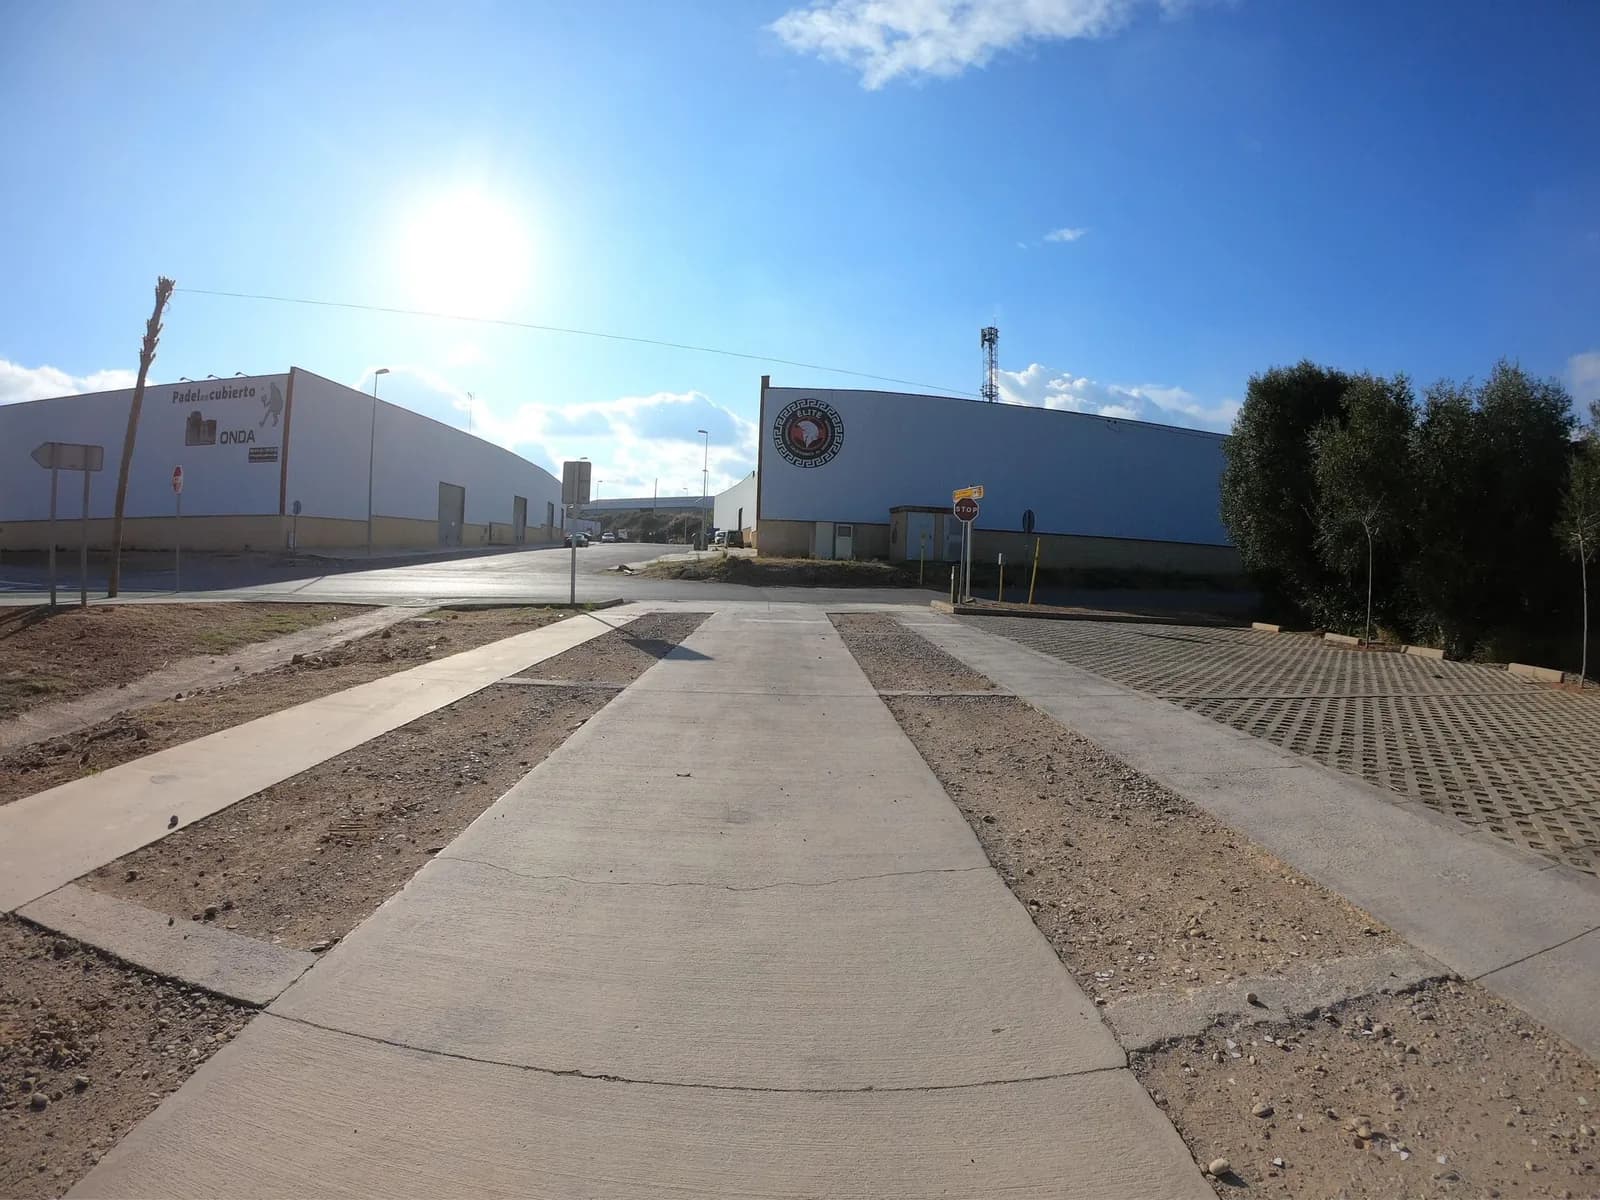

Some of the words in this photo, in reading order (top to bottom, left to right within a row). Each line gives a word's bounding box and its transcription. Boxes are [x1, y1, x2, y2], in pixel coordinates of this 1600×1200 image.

[172, 389, 201, 403] Padel
[209, 386, 256, 400] cubierto
[220, 430, 256, 444] ONDA
